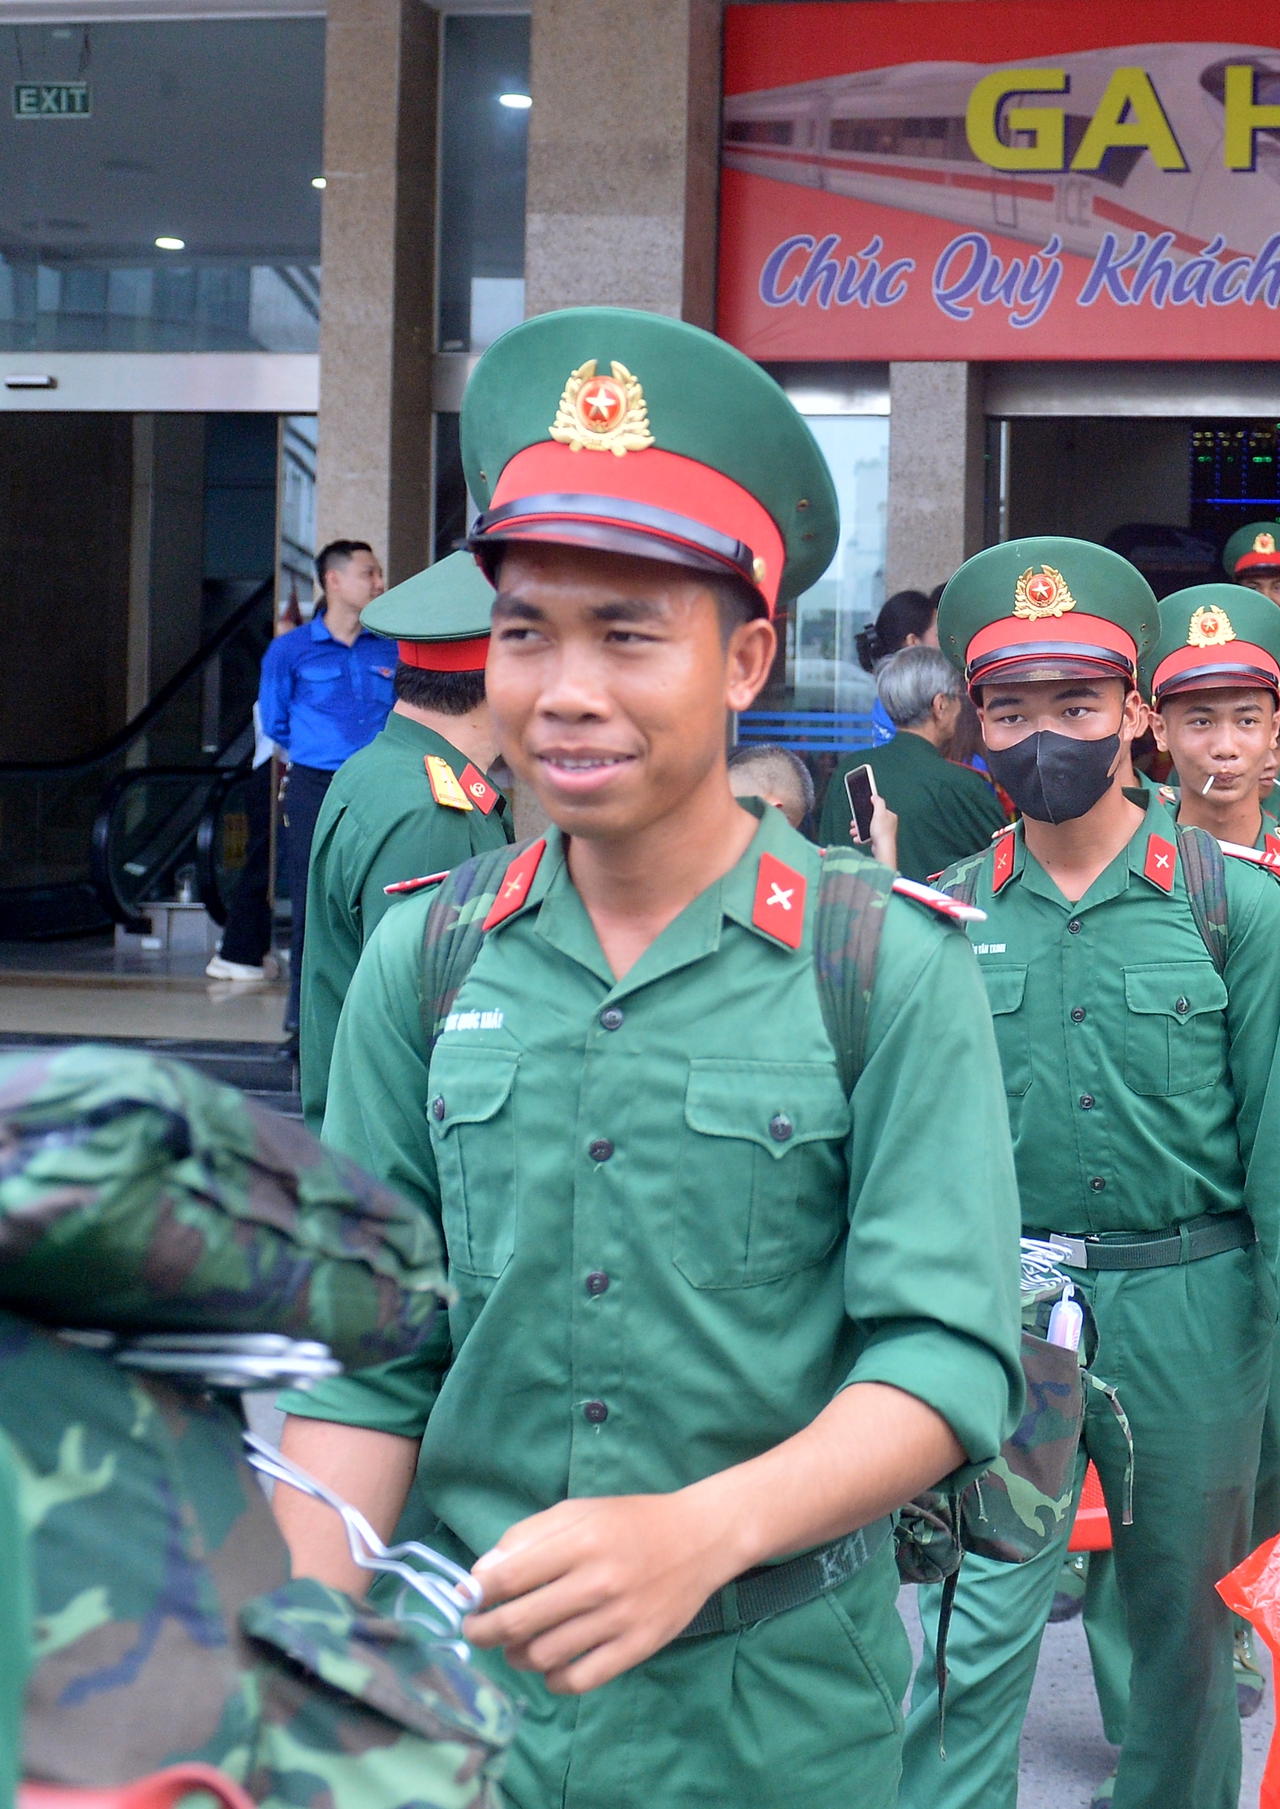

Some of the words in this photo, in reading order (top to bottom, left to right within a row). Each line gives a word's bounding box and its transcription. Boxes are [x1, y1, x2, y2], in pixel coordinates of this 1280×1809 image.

[20, 87, 87, 112] EXIT
[965, 66, 1191, 173] GA
[759, 233, 914, 309] Chúc
[932, 231, 1064, 329] Quý
